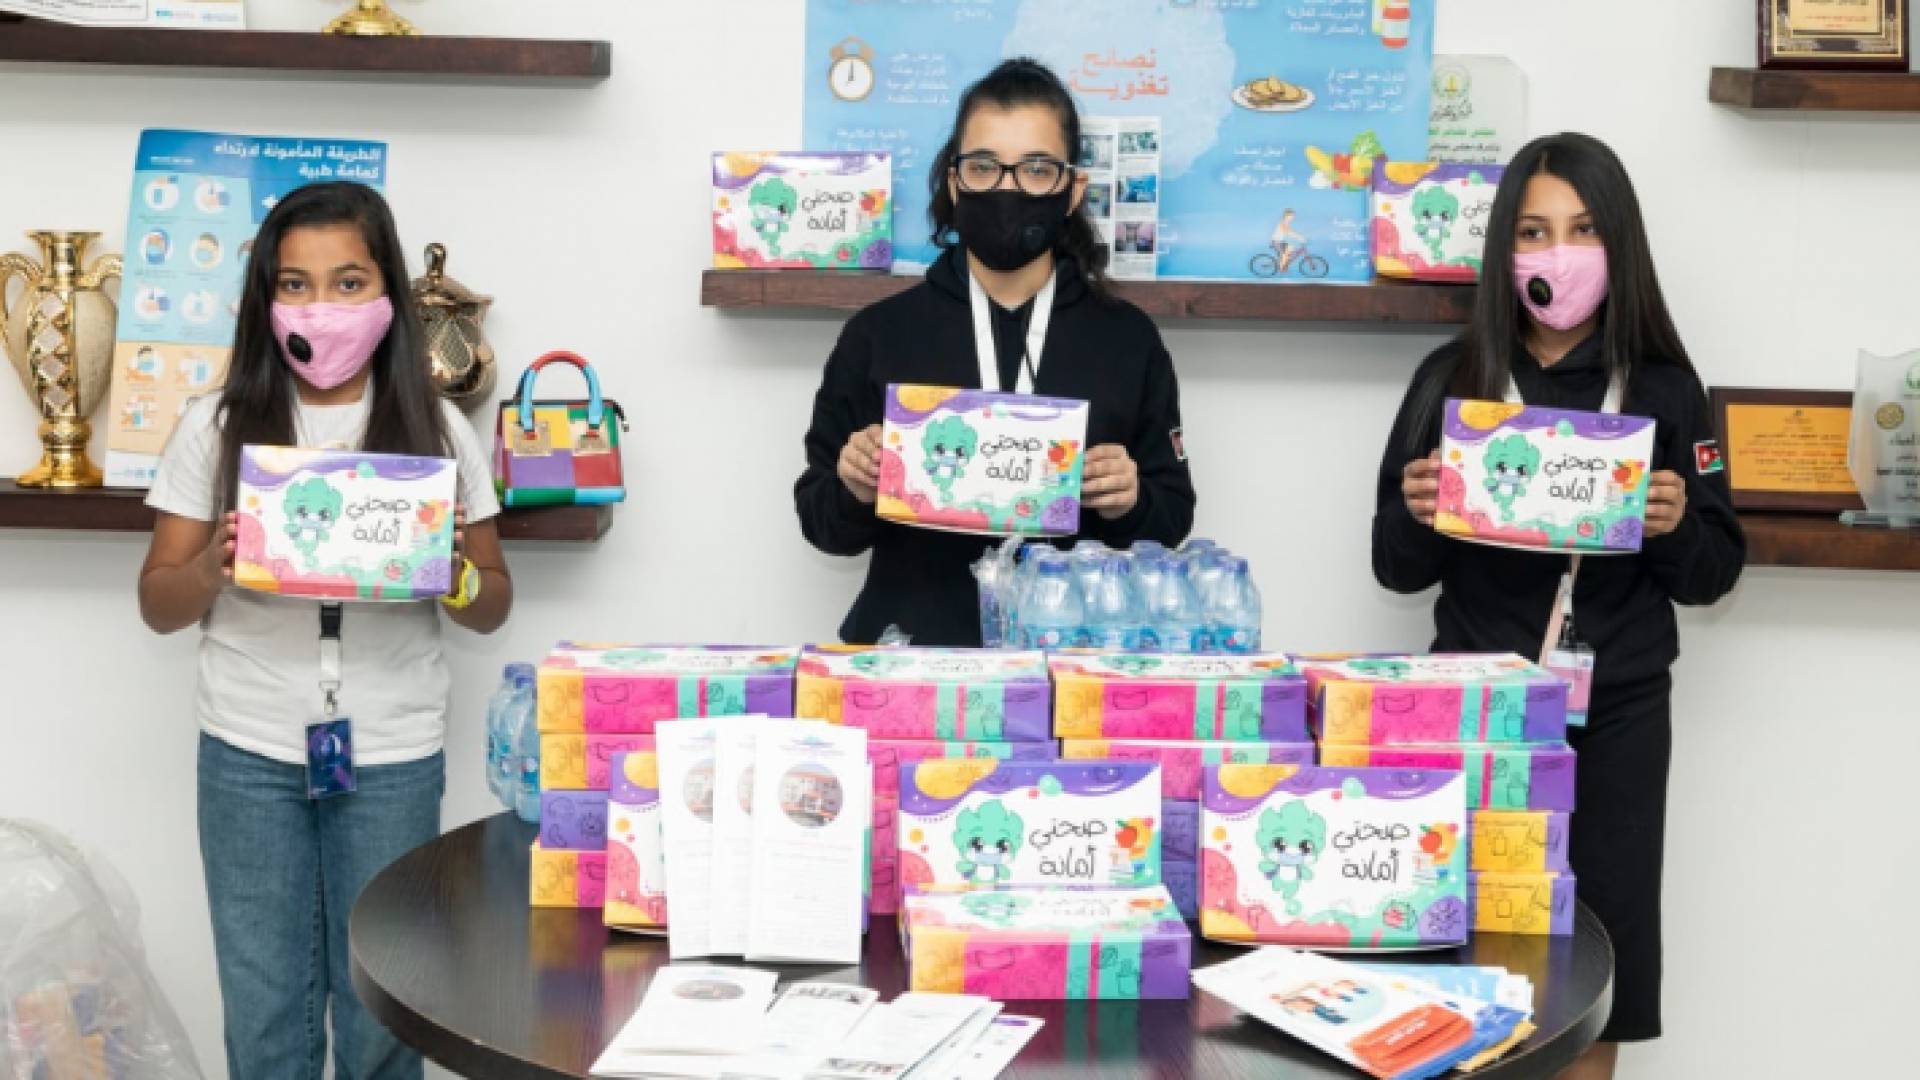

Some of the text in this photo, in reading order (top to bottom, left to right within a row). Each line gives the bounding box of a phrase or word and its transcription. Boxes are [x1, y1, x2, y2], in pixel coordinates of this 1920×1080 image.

[1083, 48, 1156, 77] نصائح
[214, 140, 380, 162] الطريقة المأمونة لارتداء
[298, 162, 380, 180] كمامة طبية
[801, 189, 853, 211] صحتي
[980, 437, 1043, 457] صحتي
[985, 457, 1033, 482] أمانة
[1544, 453, 1607, 474] صحتي
[1549, 477, 1597, 502] أمانة
[346, 494, 412, 519] صحتي
[352, 518, 401, 546] أمانة
[1029, 818, 1107, 847] صحتي
[1332, 820, 1411, 849] صحتي
[1039, 845, 1097, 878] أمانة
[1341, 848, 1400, 882] أمانة
